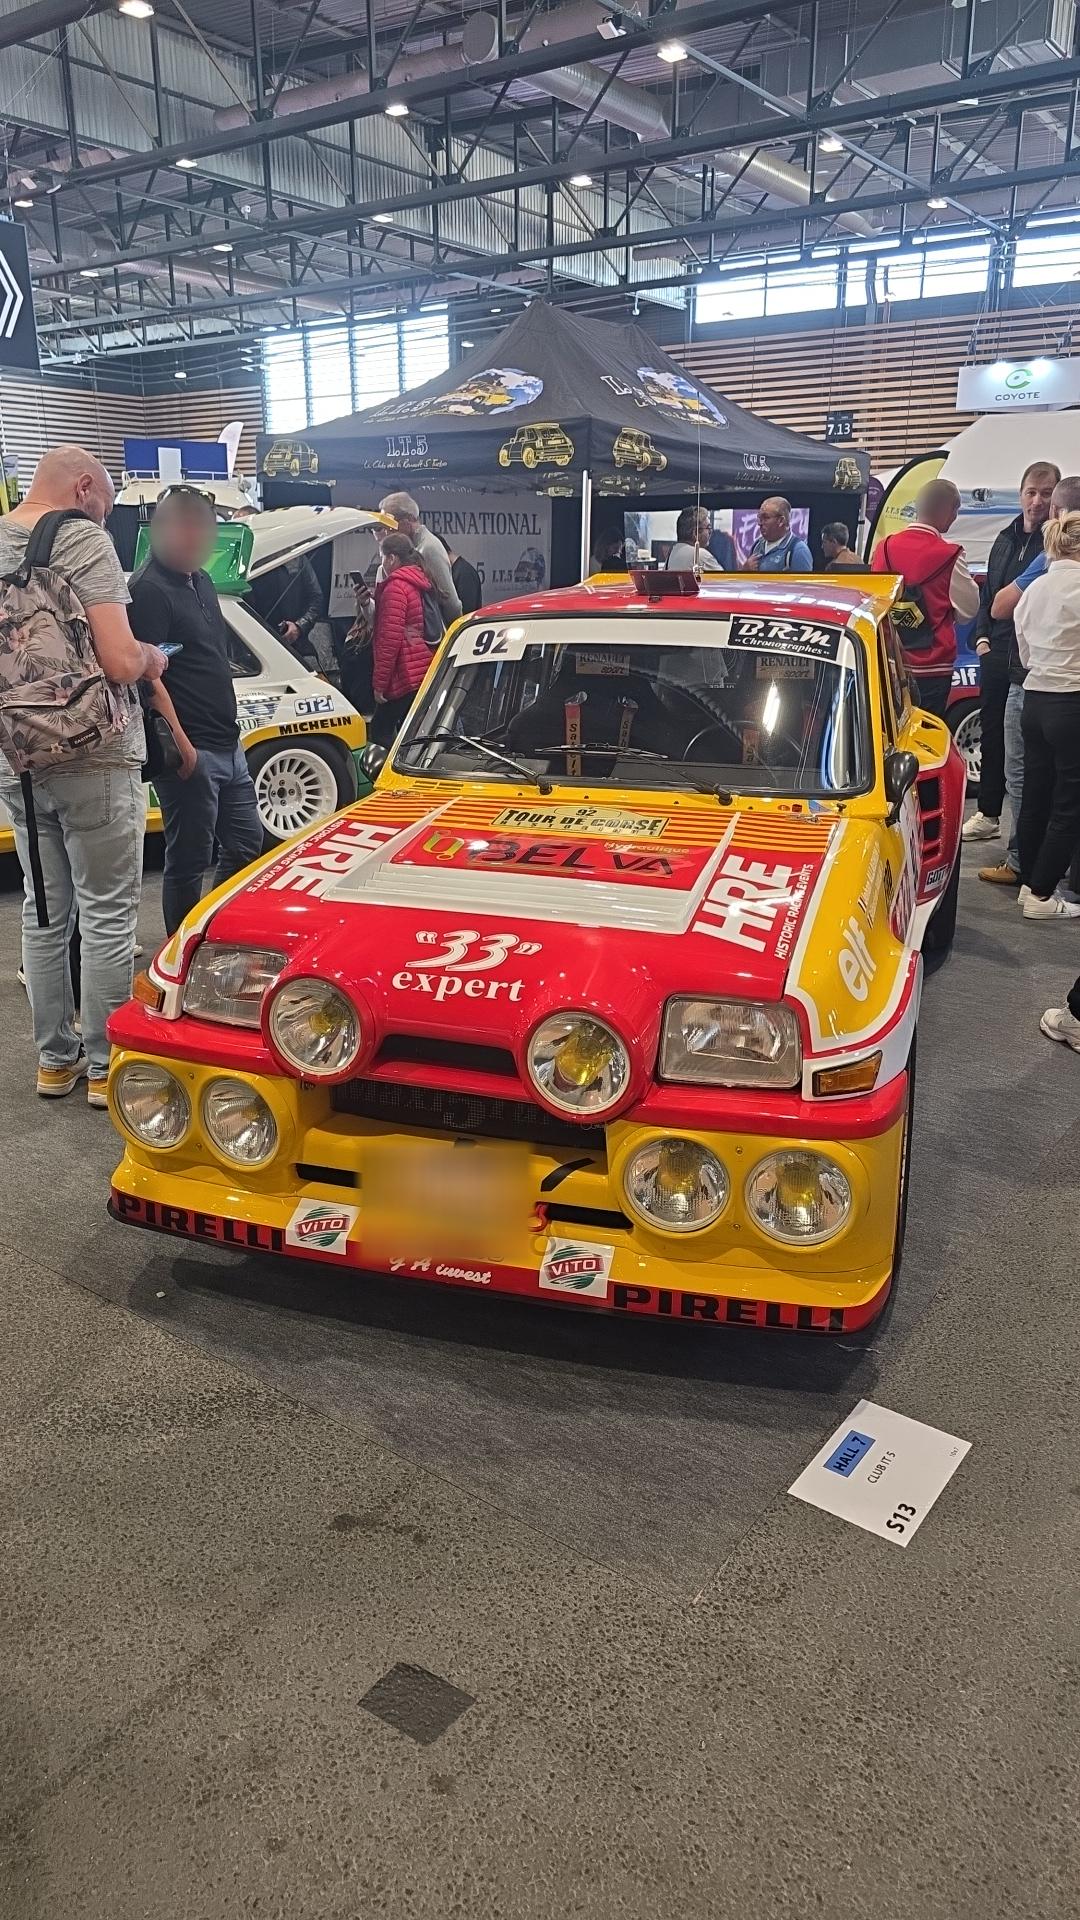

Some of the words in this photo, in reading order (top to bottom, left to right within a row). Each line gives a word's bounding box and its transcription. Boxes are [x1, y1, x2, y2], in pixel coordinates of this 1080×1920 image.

[995, 391, 1041, 401] COYOTE
[827, 423, 851, 436] 7.13
[386, 434, 429, 457] I.T.5
[419, 511, 542, 536] TERNATIONAL
[335, 573, 355, 588] I.T.
[492, 570, 513, 583] I.T.5
[472, 630, 509, 656] 92
[579, 654, 626, 664] RENAULT
[759, 656, 810, 668] RENAULT
[951, 668, 977, 686] elf
[294, 696, 334, 716] GT2i
[279, 716, 352, 735] MICHELIN
[502, 809, 556, 824] TOUR
[560, 816, 588, 826] DE
[591, 818, 662, 833] CORSE
[575, 808, 597, 817] 92
[312, 819, 347, 844] HISTORIC
[268, 822, 402, 898] HRE
[281, 842, 314, 865] RACING
[246, 864, 283, 893] EVENTS
[692, 854, 793, 953] HRE
[774, 917, 798, 960] HISTORIC
[796, 863, 814, 892] EVENTS
[838, 916, 877, 1002] elf
[391, 971, 525, 1002] expert
[117, 1191, 283, 1252] PIRELLI
[435, 1263, 492, 1285] invest
[613, 1284, 845, 1332] PIRELLI
[833, 1446, 860, 1472] HALL
[851, 1435, 867, 1447] 7
[867, 1463, 886, 1484] CLUB
[887, 1450, 896, 1459] 5
[886, 1503, 917, 1534] S13
